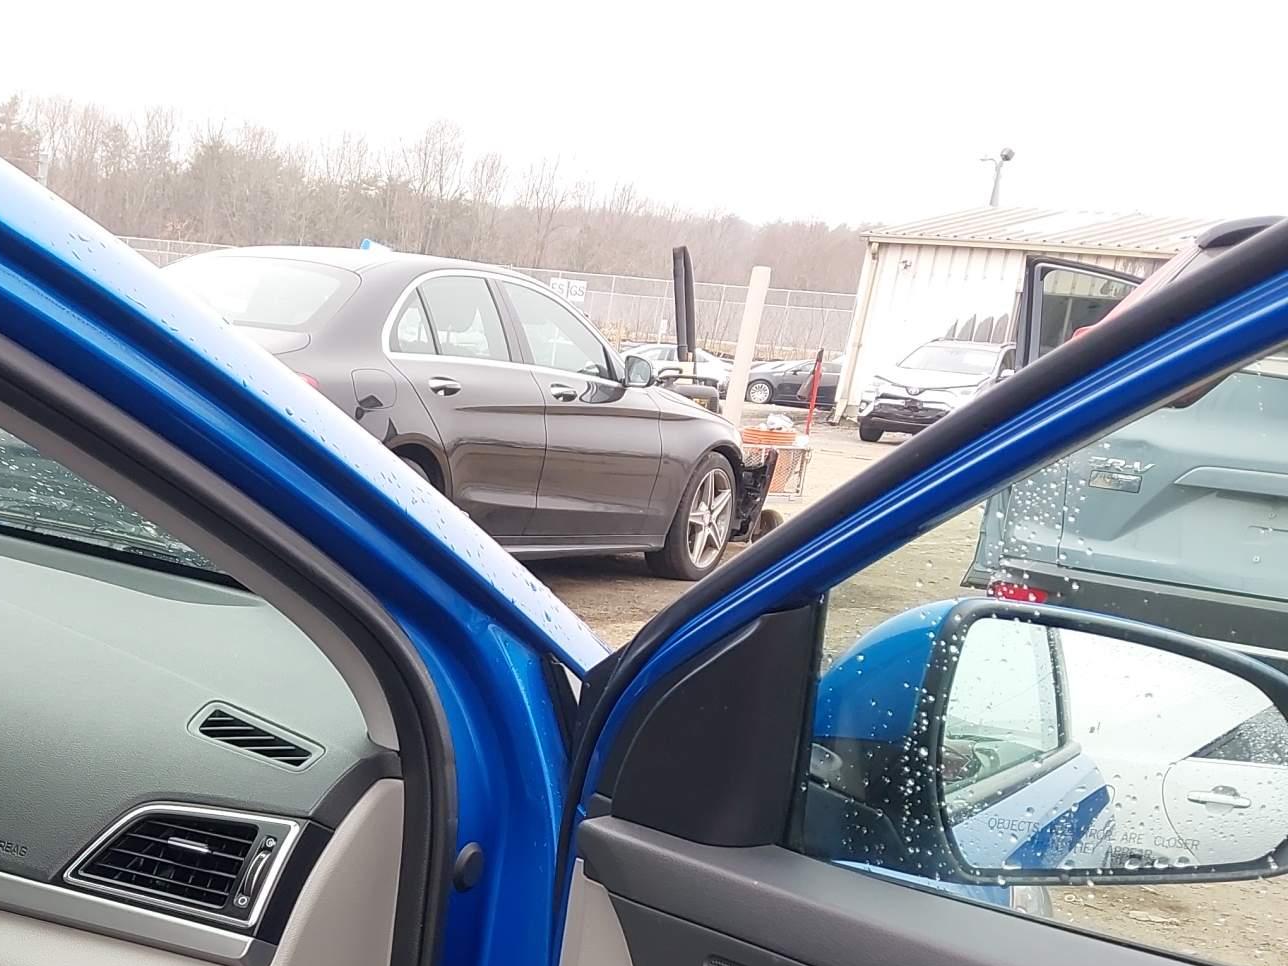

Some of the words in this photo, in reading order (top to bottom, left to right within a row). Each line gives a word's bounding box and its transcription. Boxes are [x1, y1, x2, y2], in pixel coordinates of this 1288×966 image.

[1088, 455, 1156, 475] CR-V
[988, 816, 1040, 833] OBJECTS
[1121, 831, 1145, 845] ARE
[1153, 835, 1200, 850] CLOSER
